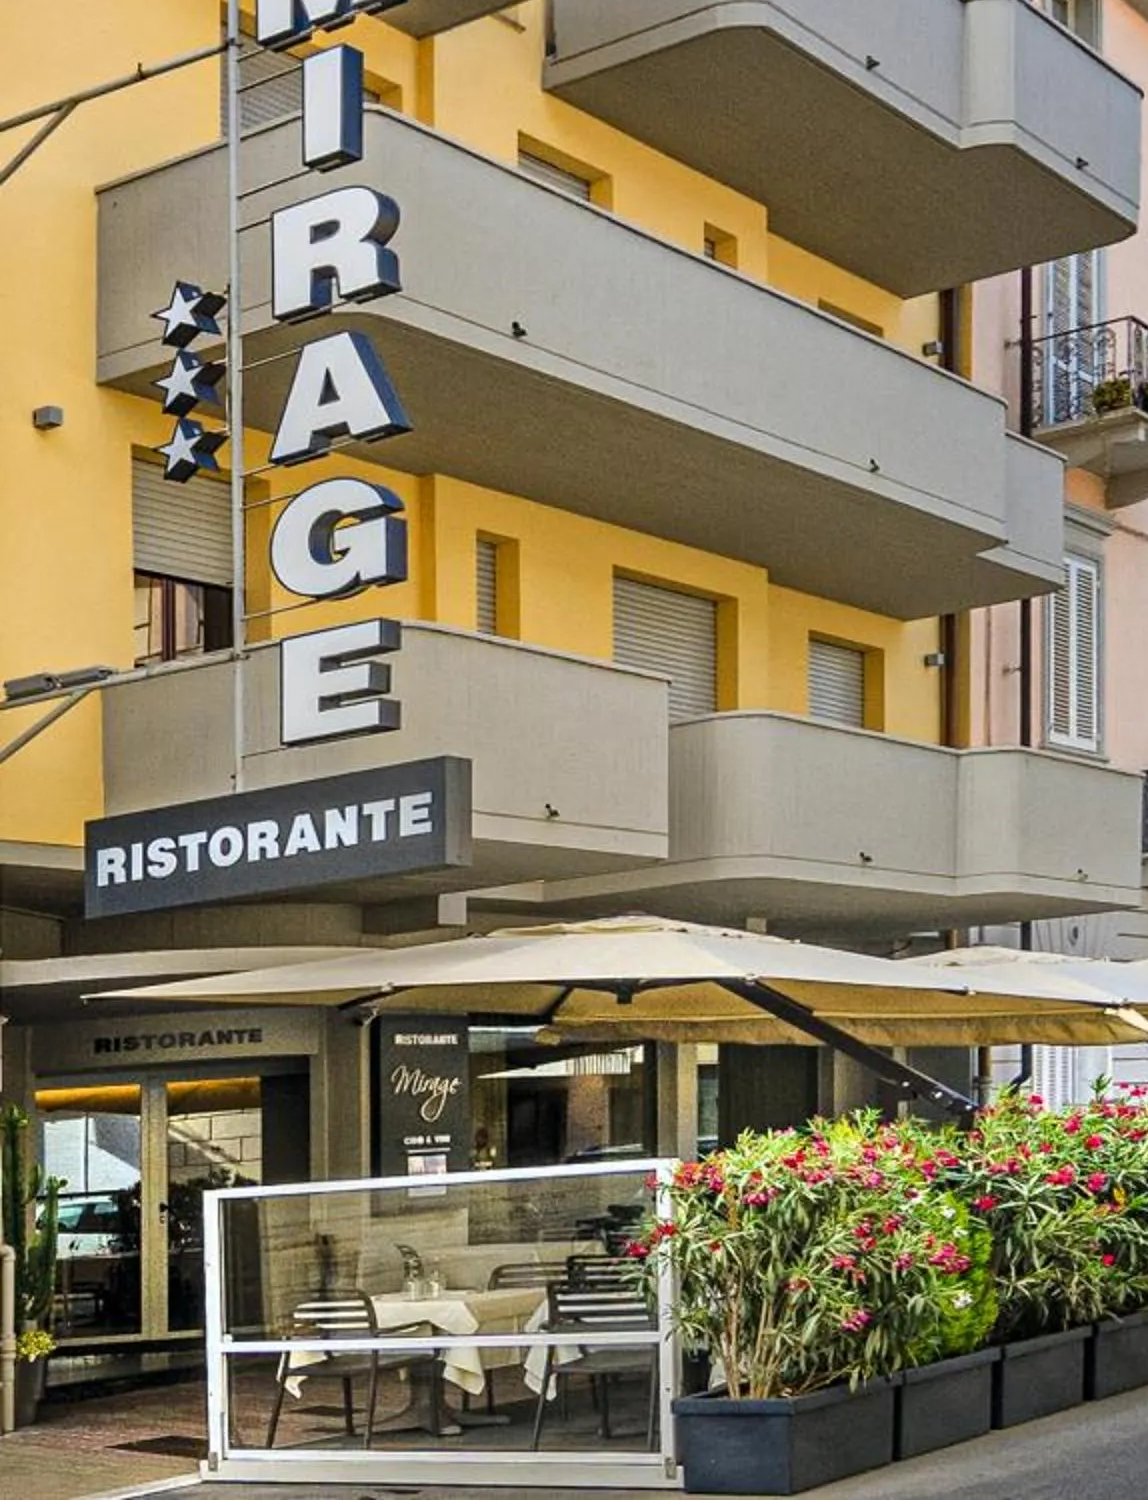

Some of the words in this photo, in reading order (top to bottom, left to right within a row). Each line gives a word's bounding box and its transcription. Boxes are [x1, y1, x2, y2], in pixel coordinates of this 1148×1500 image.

[96, 791, 433, 887] RISTORANTE
[93, 1028, 263, 1054] RISTORANTE
[394, 1033, 459, 1045] RISTORANTE
[391, 1065, 462, 1123] Mirage
